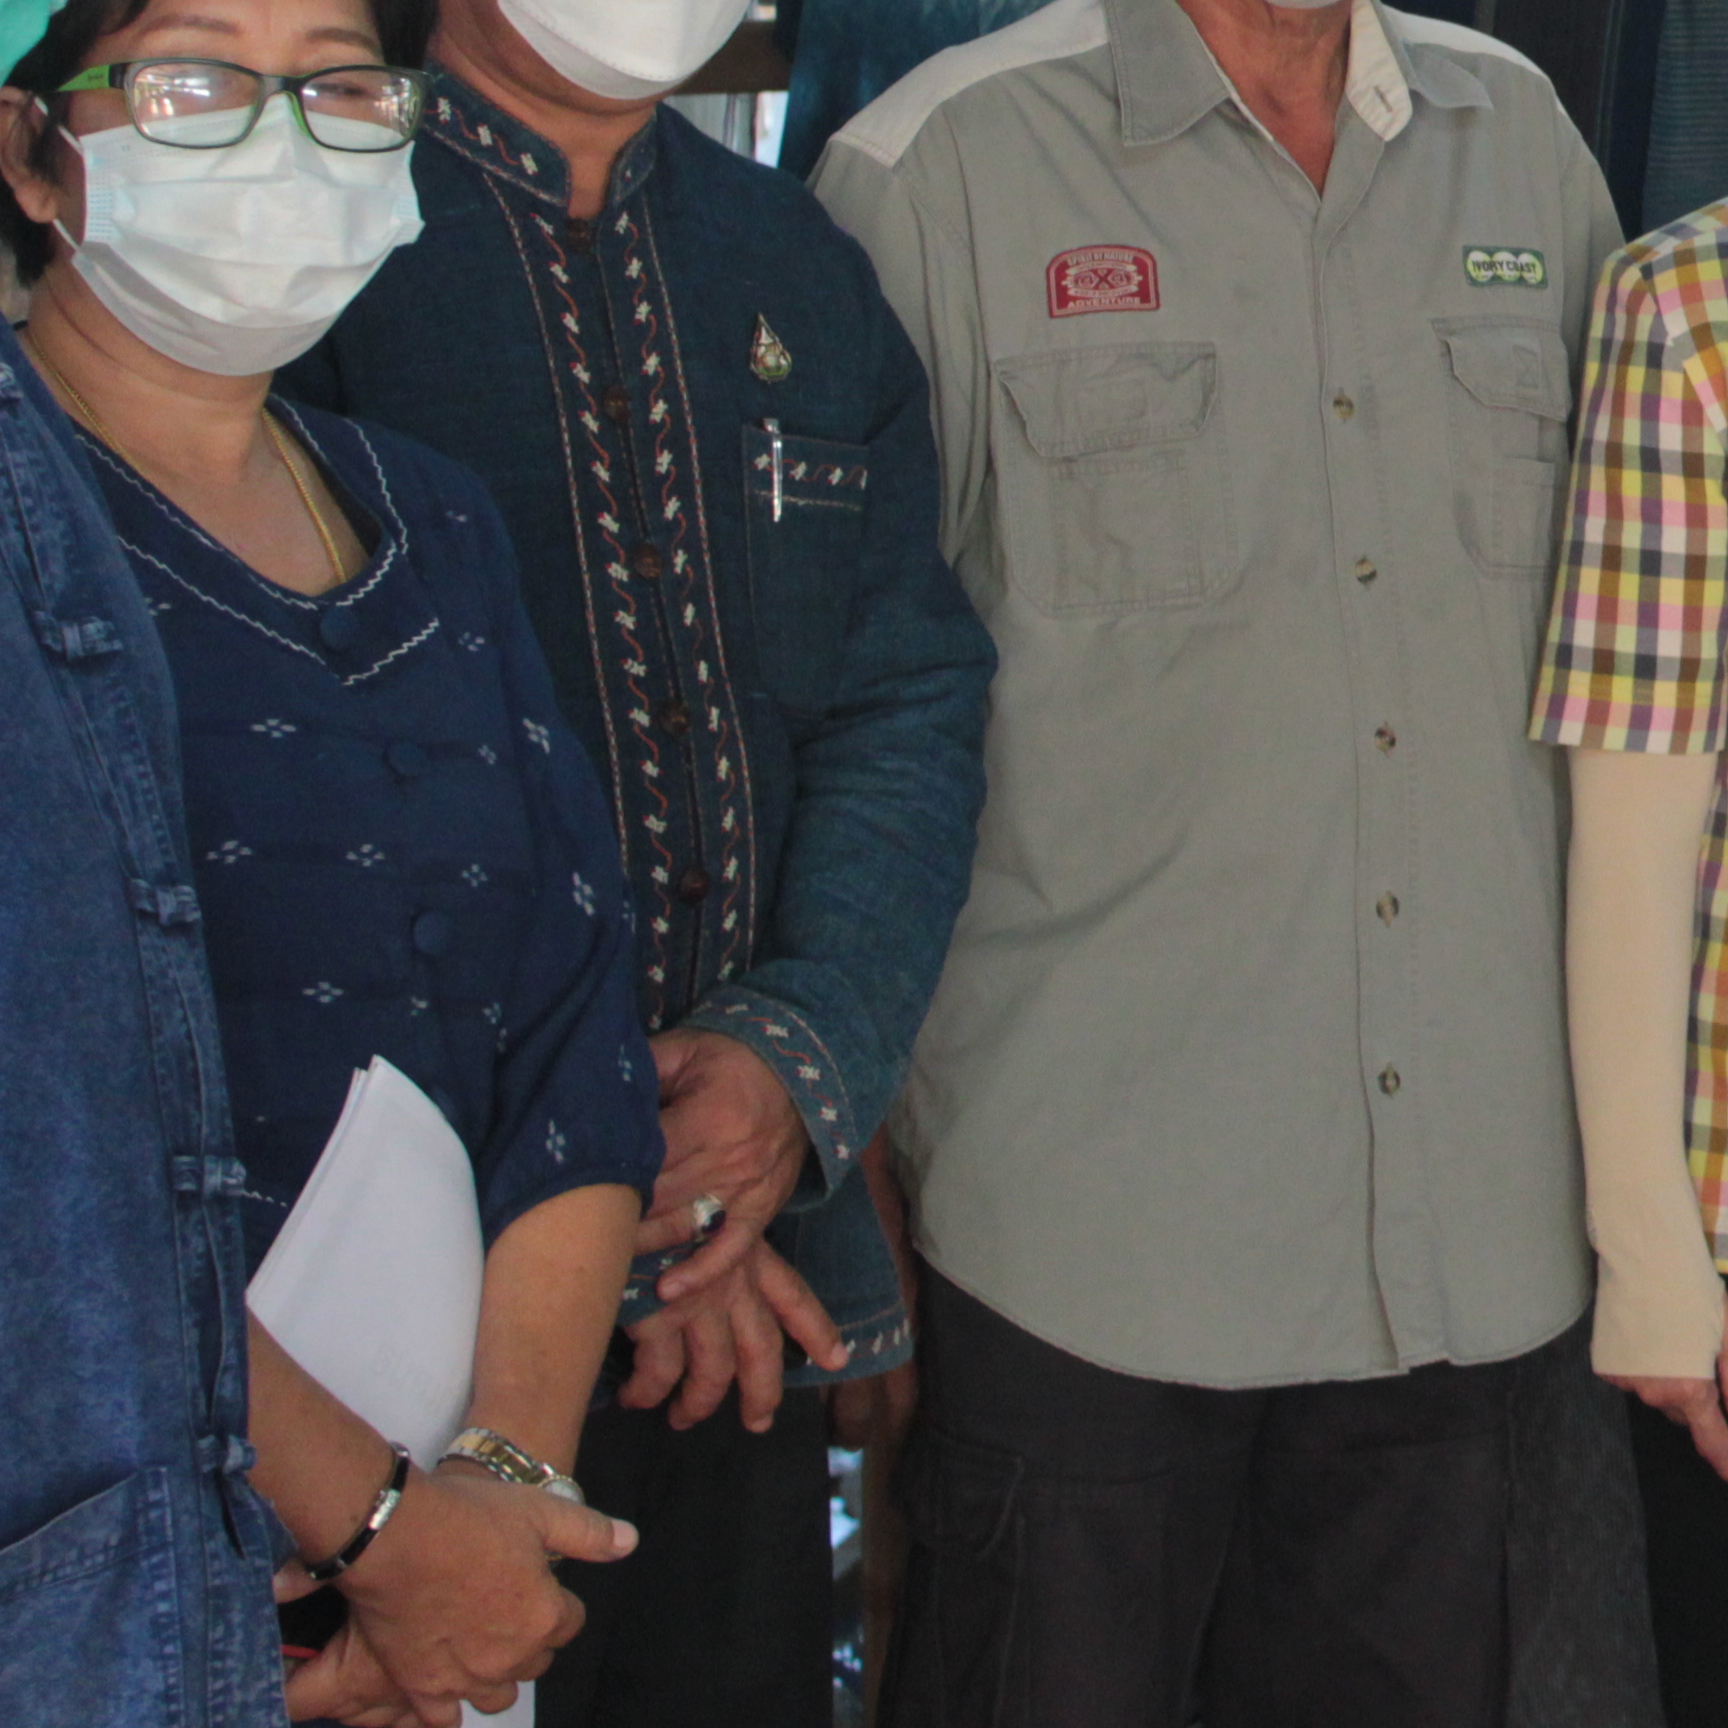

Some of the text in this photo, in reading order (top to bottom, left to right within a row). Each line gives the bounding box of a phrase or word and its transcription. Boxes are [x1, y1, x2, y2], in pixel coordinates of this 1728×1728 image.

[1471, 260, 1536, 274] IVORY COAST
[1067, 297, 1141, 308] ADVENTURE
